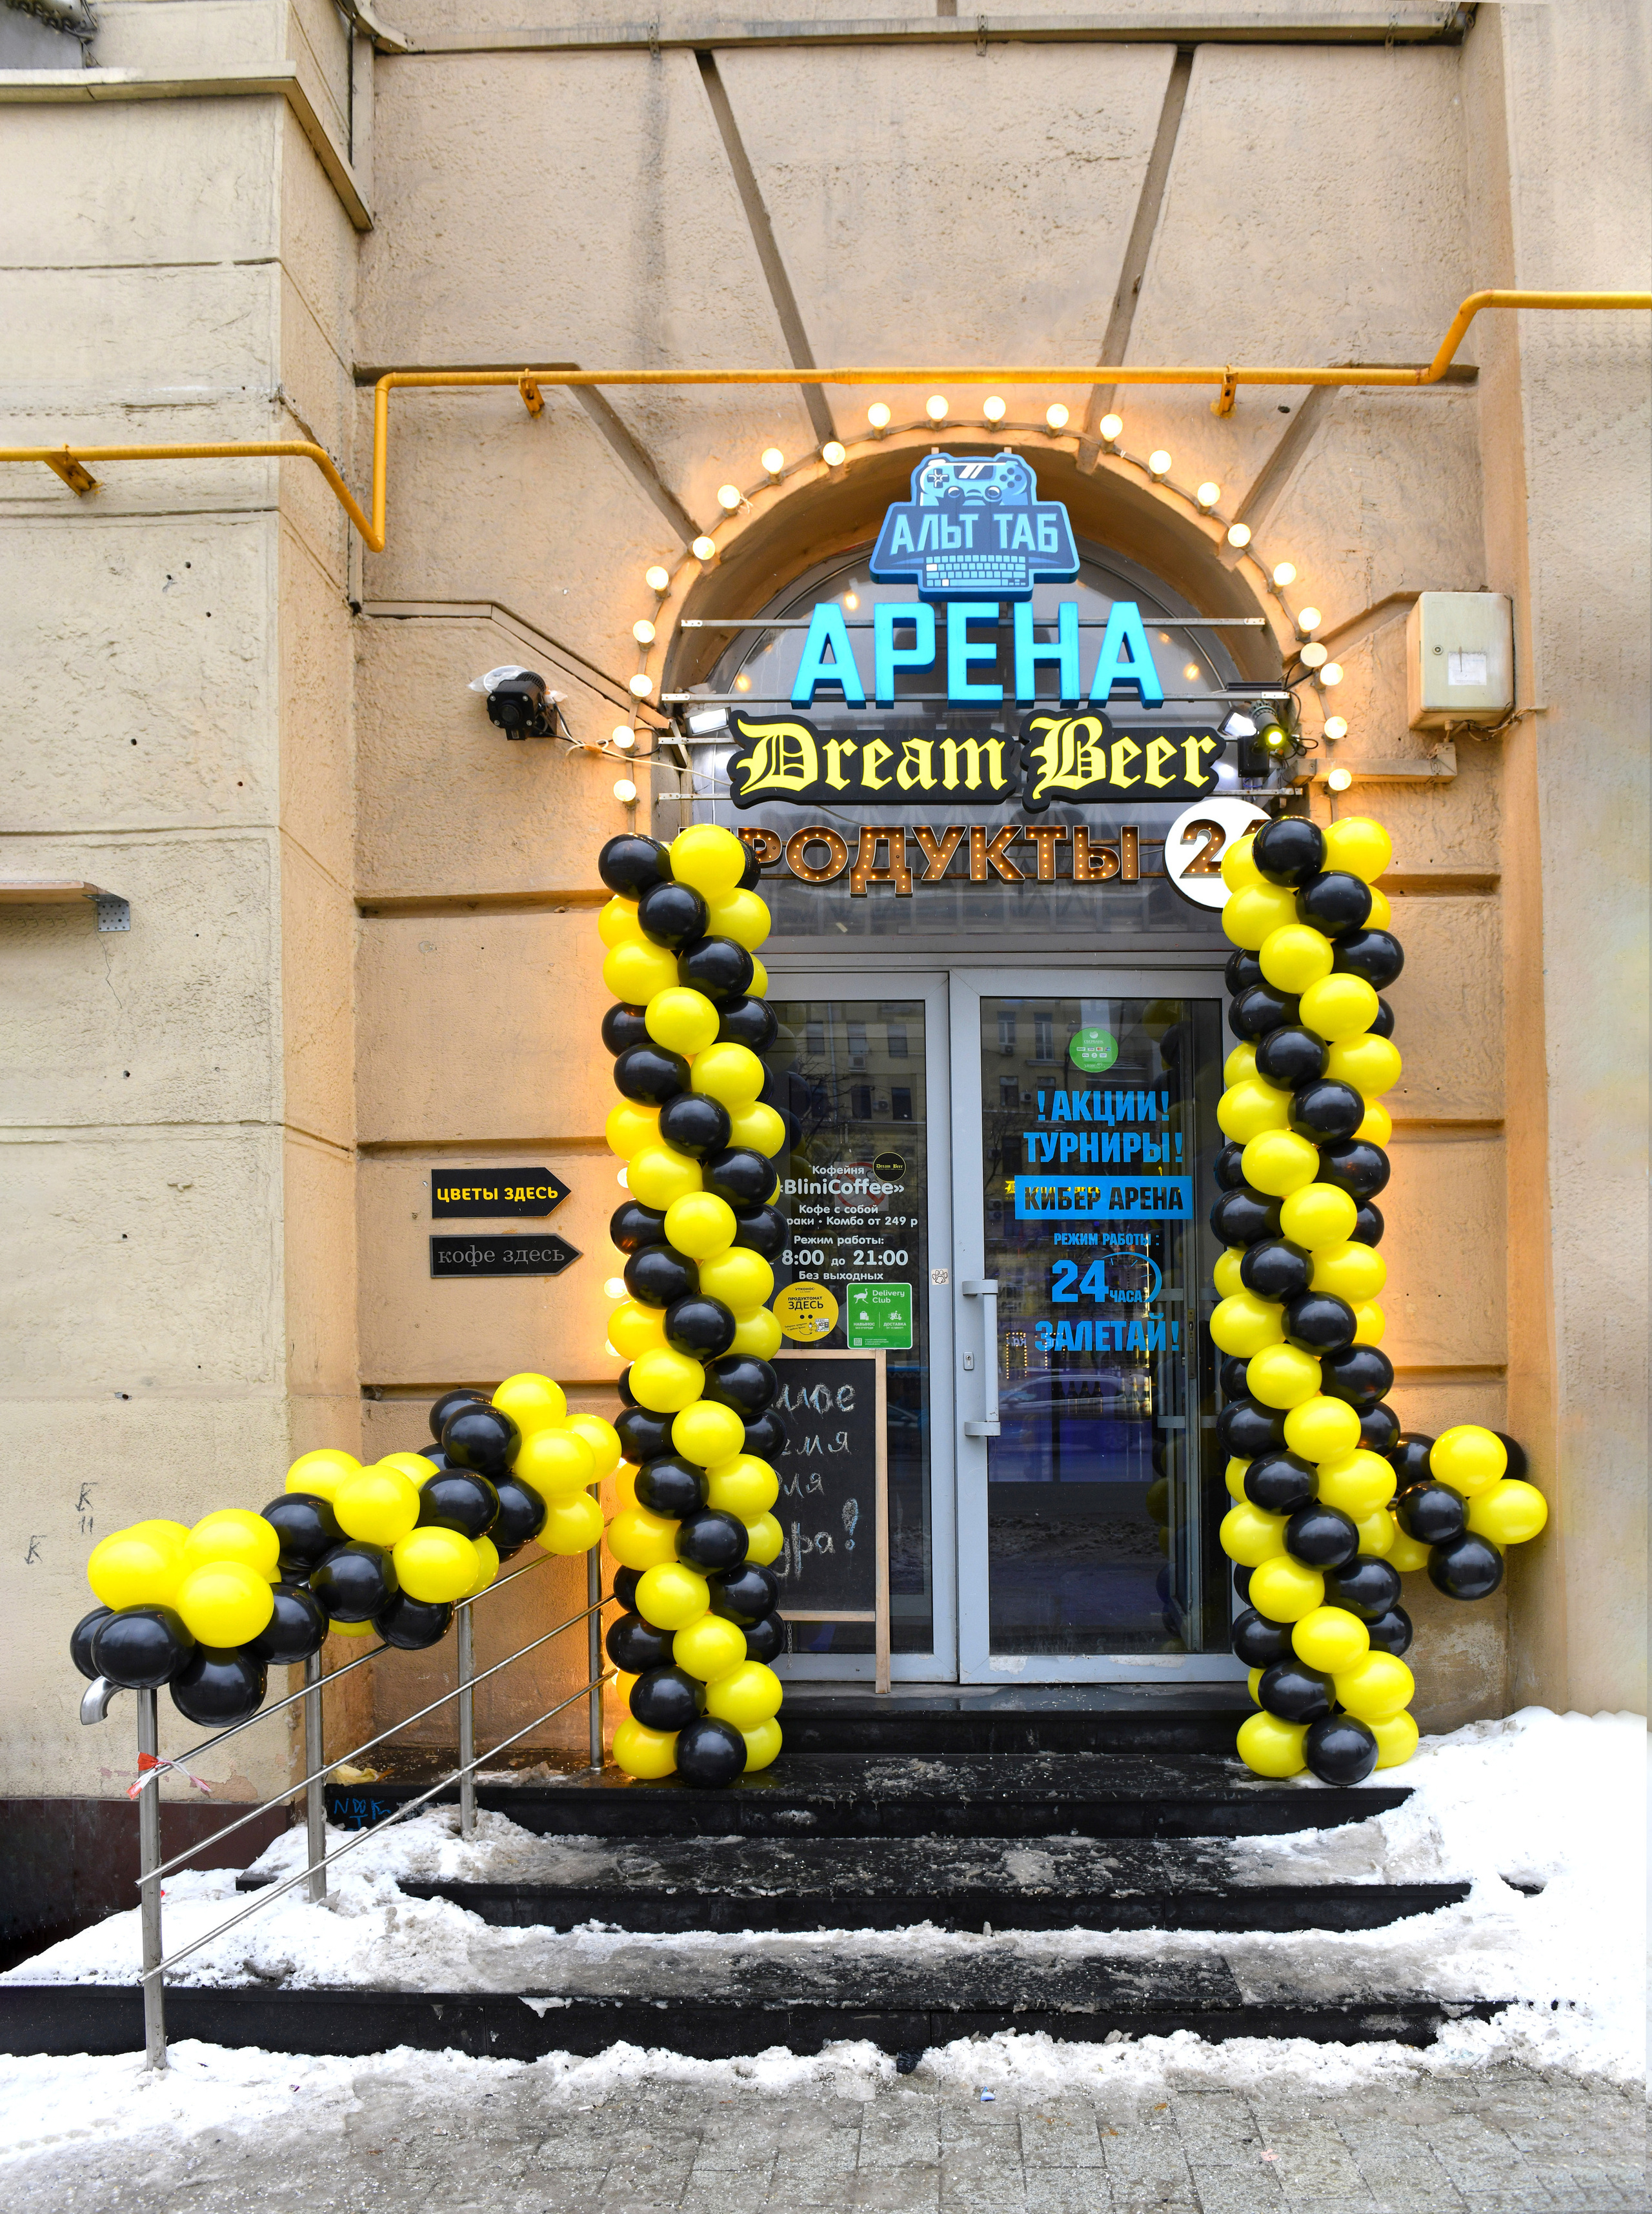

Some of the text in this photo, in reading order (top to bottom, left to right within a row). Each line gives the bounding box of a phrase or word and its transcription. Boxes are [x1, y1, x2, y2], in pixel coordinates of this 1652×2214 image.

[889, 514, 1059, 556] АЛЬТ ТАБ
[791, 601, 1164, 709] АРЕНА
[737, 716, 1217, 800] Dream Beer
[724, 825, 1141, 898] РОДУКТЫ
[1037, 1091, 1169, 1127] !АКЦИИ!
[1023, 1132, 1183, 1163] ТУРНИРЫ!
[812, 1165, 865, 1176] Кофейня
[437, 1186, 559, 1203] ЦВЕТЫ ЗДЕСЬ
[1025, 1187, 1184, 1210] КИБЕР АРЕНА
[799, 1204, 831, 1216] Кофе
[843, 1204, 879, 1214] собой
[786, 1217, 814, 1226] раки
[826, 1216, 864, 1225] Комбо
[885, 1216, 907, 1225] 249
[911, 1218, 918, 1227] р
[794, 1235, 884, 1246] Режим работы:
[1054, 1233, 1098, 1245] РЕЖИМ
[438, 1245, 565, 1267] кофе здесь
[781, 1249, 909, 1267] 8:00 до 21:00
[799, 1271, 884, 1282] Без выходных
[1051, 1260, 1143, 1303] 24 ЧАСА
[788, 1301, 824, 1311] ЗДЕСЬ
[1034, 1313, 1180, 1352] ЗАЛЕТАЙ!
